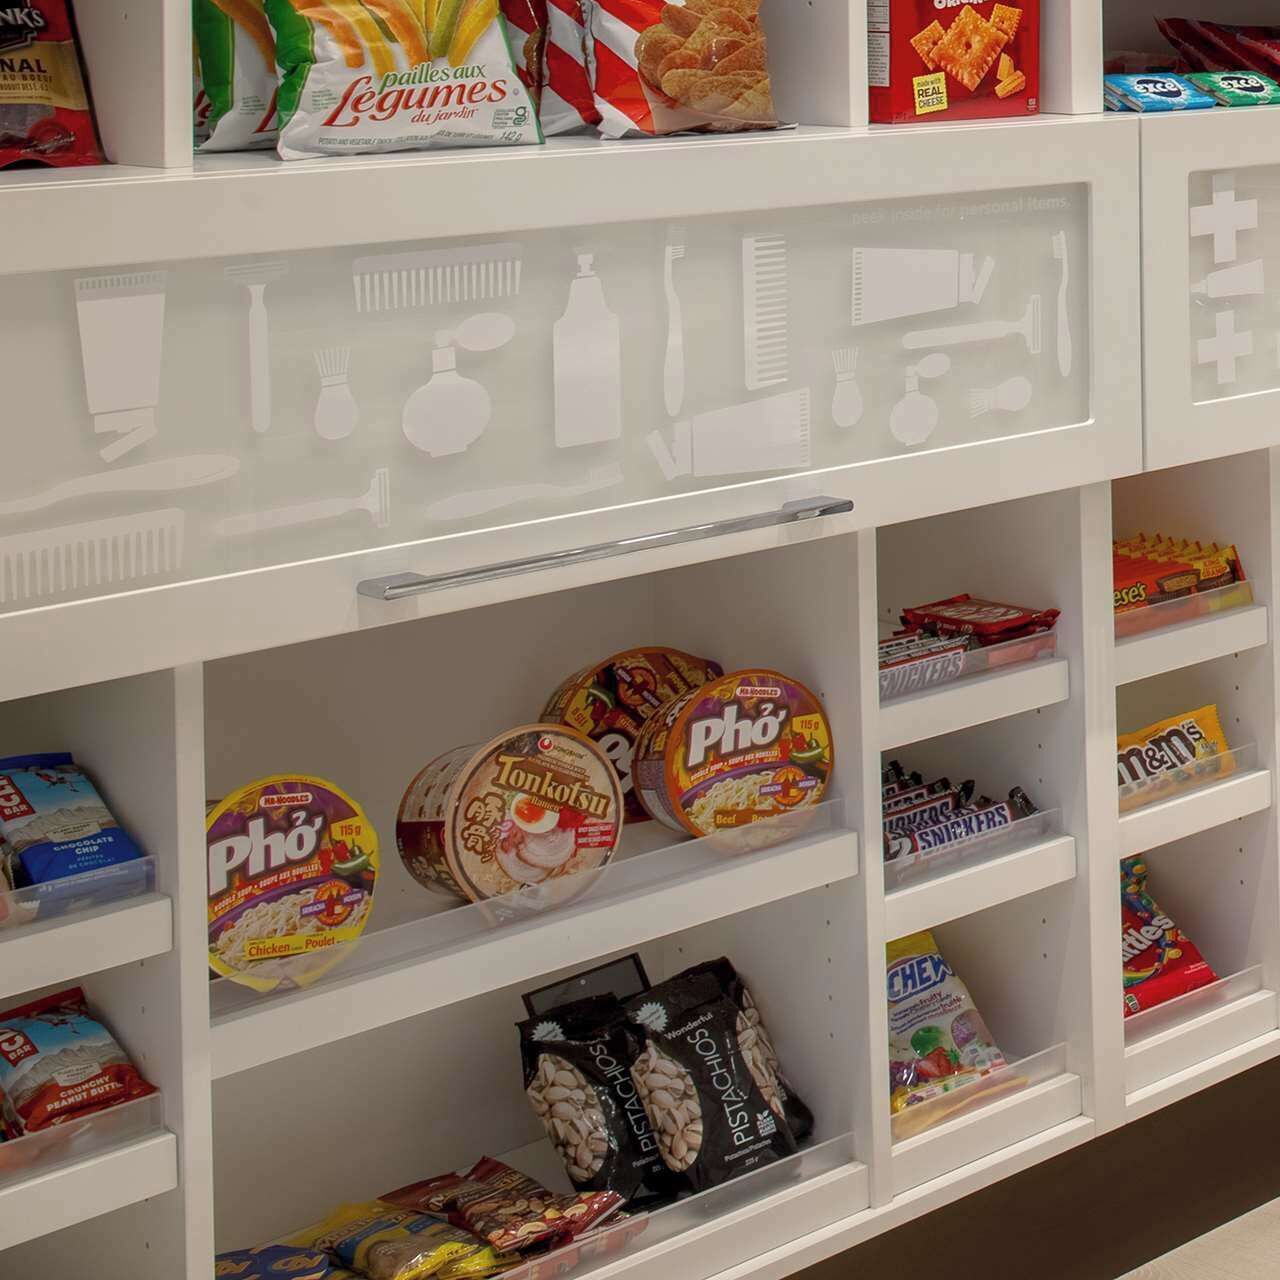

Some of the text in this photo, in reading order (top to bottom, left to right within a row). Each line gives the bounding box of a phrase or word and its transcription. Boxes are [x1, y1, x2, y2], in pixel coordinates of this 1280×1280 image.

[380, 63, 486, 94] pailles aux
[321, 76, 508, 127] Légumes
[918, 87, 944, 99] REAL
[918, 97, 945, 109] CHEESE
[411, 111, 429, 124] du
[800, 720, 813, 730] 115
[497, 754, 609, 819] Tonkotsu
[3, 804, 28, 816] BAR
[716, 814, 737, 826] Beef
[917, 804, 1010, 851] SNICKERS
[339, 825, 354, 836] 115
[53, 836, 114, 852] CHOCOLATE
[75, 845, 101, 855] CHIP
[248, 935, 335, 958] Chicken Poulet
[663, 1011, 714, 1041] Wonderful
[8, 1044, 32, 1061] BAR
[59, 1075, 112, 1099] CRUNCHY
[687, 1028, 755, 1146] PISTACHIOS
[46, 1092, 88, 1112] PEANUT
